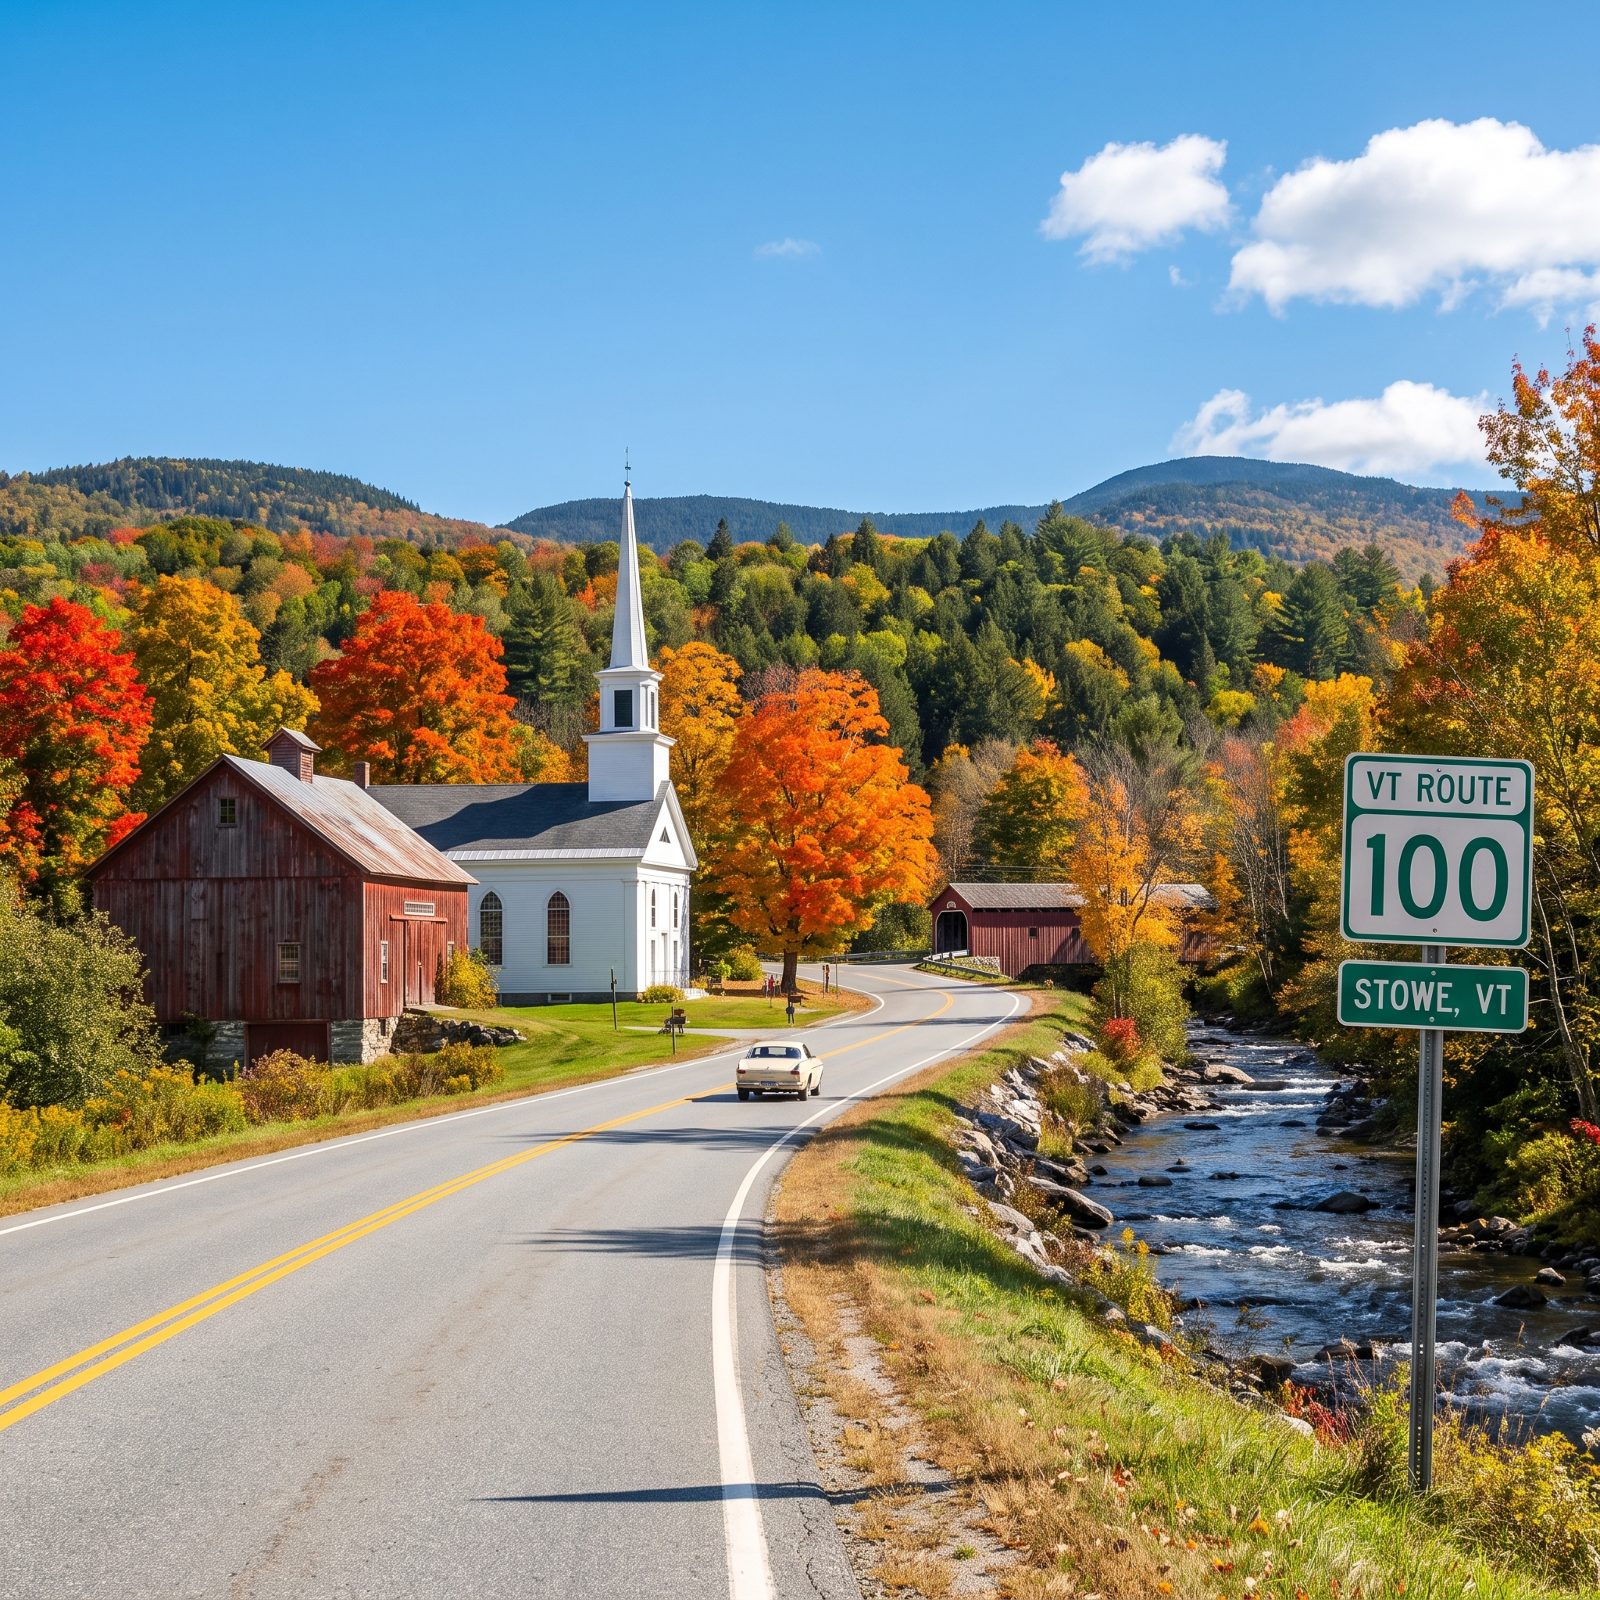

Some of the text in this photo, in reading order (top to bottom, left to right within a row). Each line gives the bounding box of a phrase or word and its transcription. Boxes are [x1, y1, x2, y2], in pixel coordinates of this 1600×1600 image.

[1366, 771, 1512, 806] VT ROUTE
[1366, 833, 1509, 922] 100
[1353, 978, 1512, 1017] STOWE, VT
